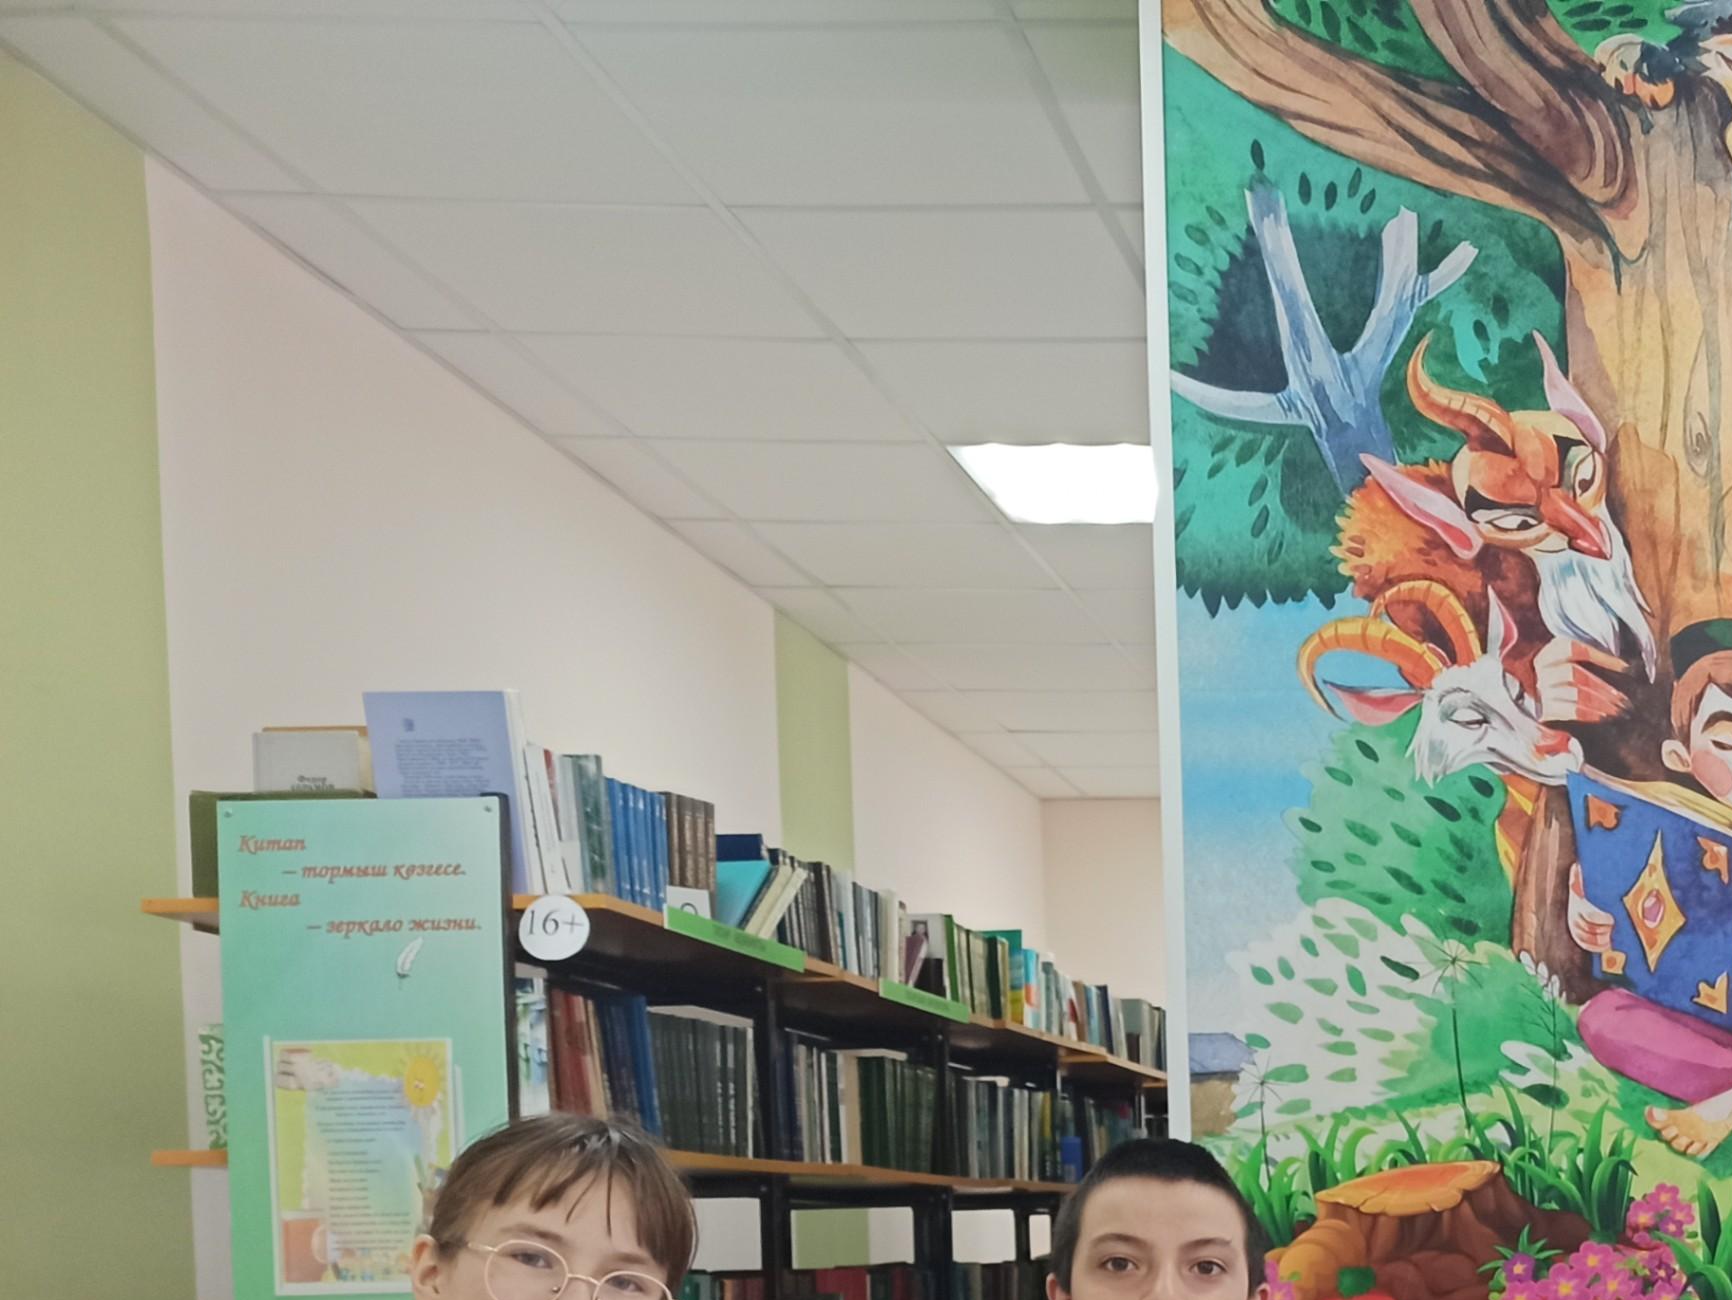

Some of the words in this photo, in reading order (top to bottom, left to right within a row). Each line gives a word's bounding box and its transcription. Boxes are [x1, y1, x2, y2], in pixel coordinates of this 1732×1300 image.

[239, 834, 307, 854] Китап
[302, 864, 387, 884] тормыш
[239, 890, 301, 910] Книга
[326, 917, 403, 939] зеркало
[408, 915, 482, 932] жизни.
[526, 907, 584, 938] 16+
